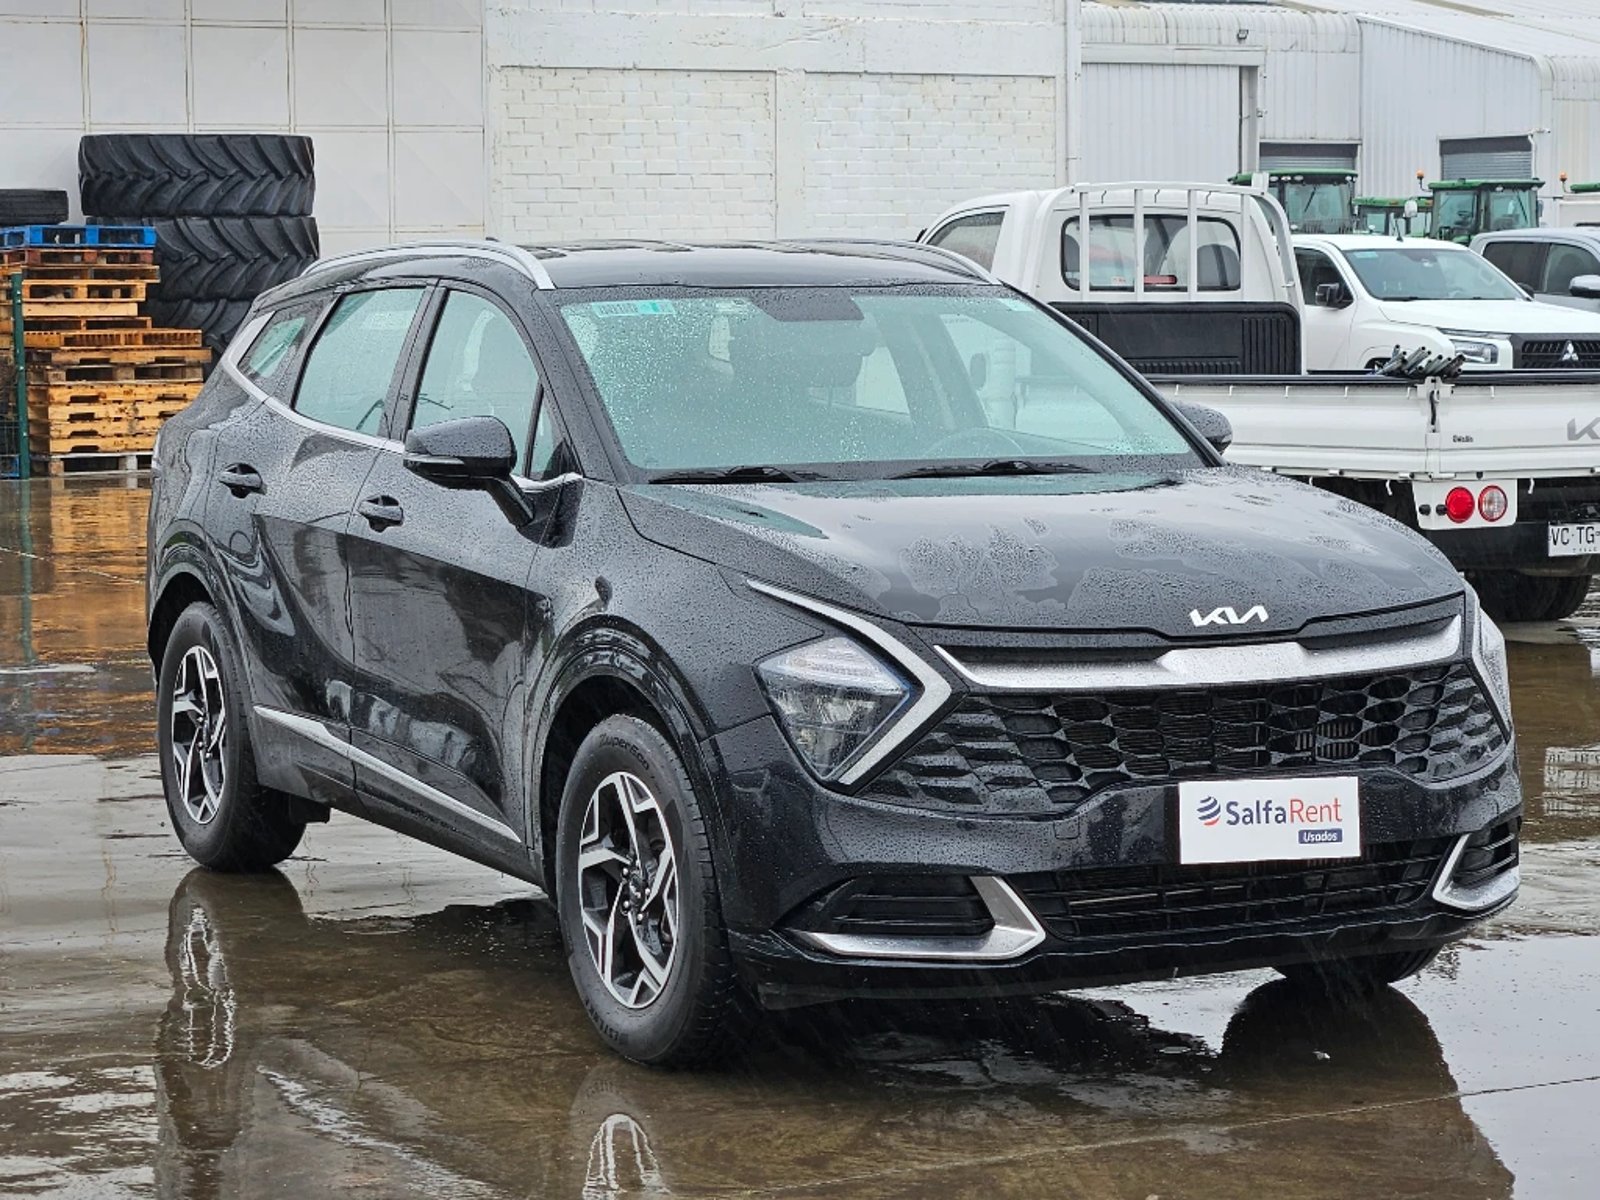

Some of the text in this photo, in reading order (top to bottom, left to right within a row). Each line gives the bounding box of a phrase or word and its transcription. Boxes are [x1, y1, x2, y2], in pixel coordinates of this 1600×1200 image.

[1189, 605, 1269, 627] KIA
[1225, 797, 1343, 826] SalfaRent
[1303, 830, 1338, 843] Usados
